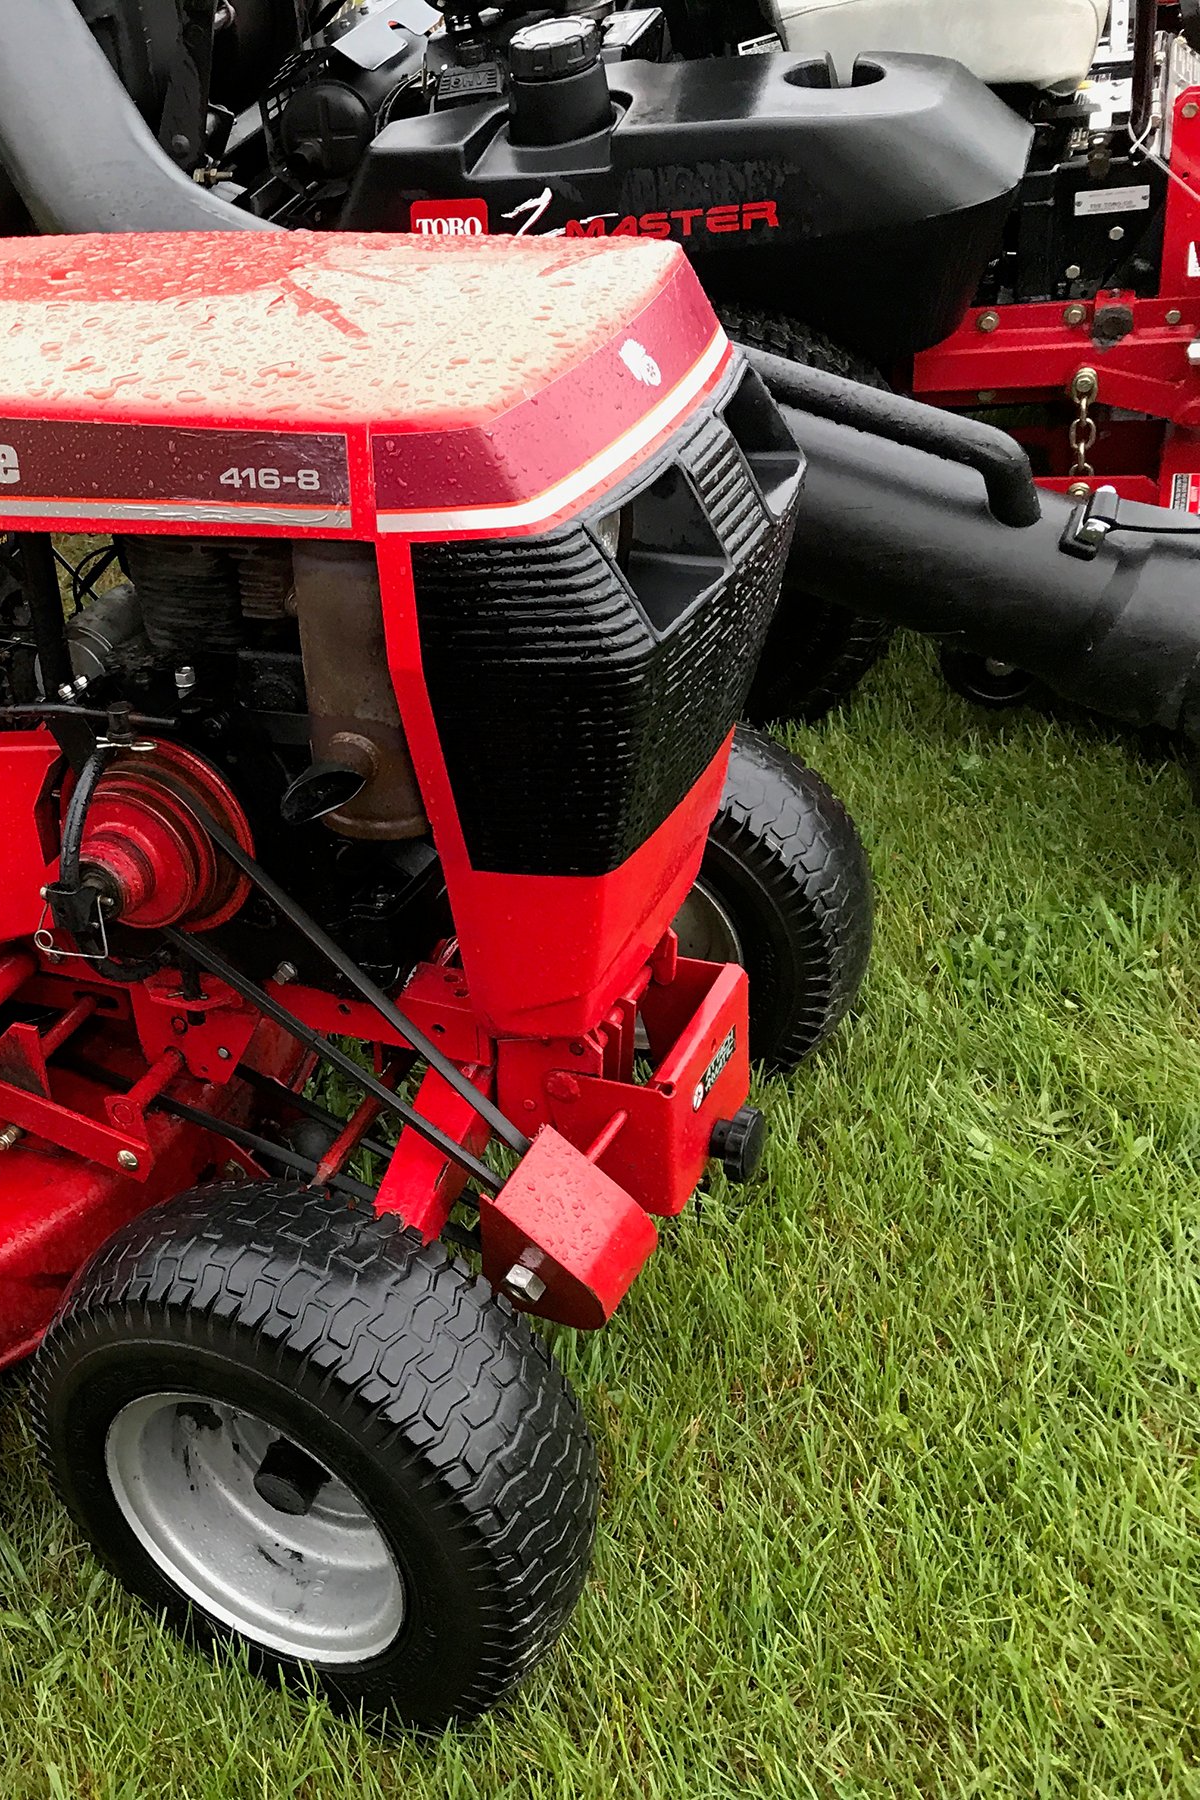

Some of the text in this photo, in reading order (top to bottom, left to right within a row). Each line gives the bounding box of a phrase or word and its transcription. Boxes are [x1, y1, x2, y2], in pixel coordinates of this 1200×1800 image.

[416, 216, 483, 236] TORO
[565, 200, 780, 239] MASTER
[219, 467, 320, 490] 416-8
